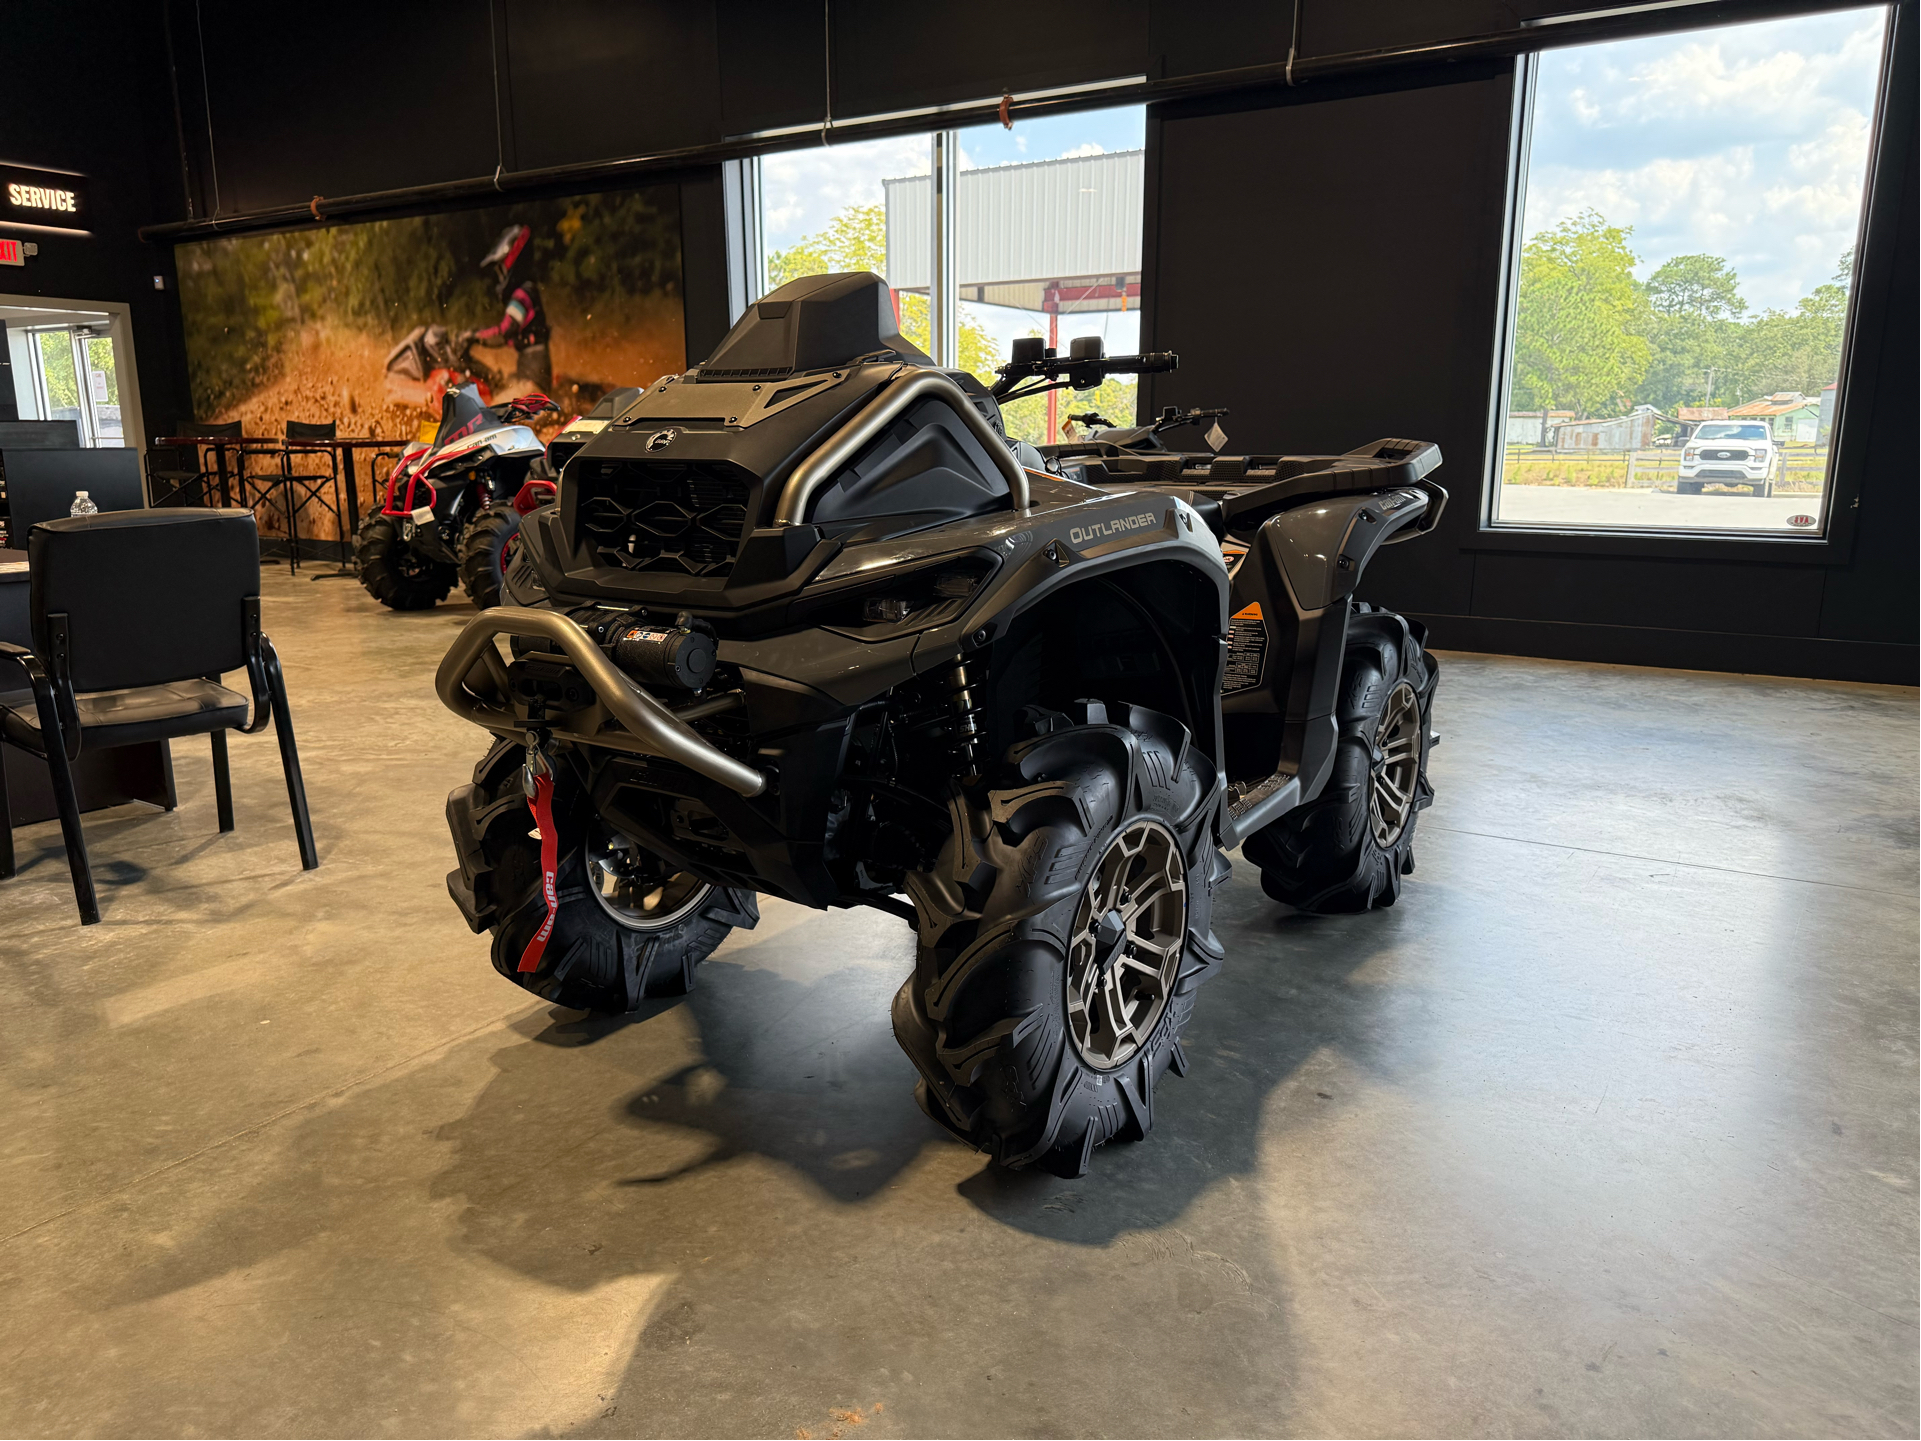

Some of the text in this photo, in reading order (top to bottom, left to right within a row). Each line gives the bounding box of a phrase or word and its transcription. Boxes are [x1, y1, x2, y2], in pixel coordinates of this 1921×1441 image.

[8, 183, 77, 213] SERVICE
[0, 240, 17, 262] XIT
[1069, 512, 1157, 544] OUTLANDER
[536, 870, 558, 943] can-am
